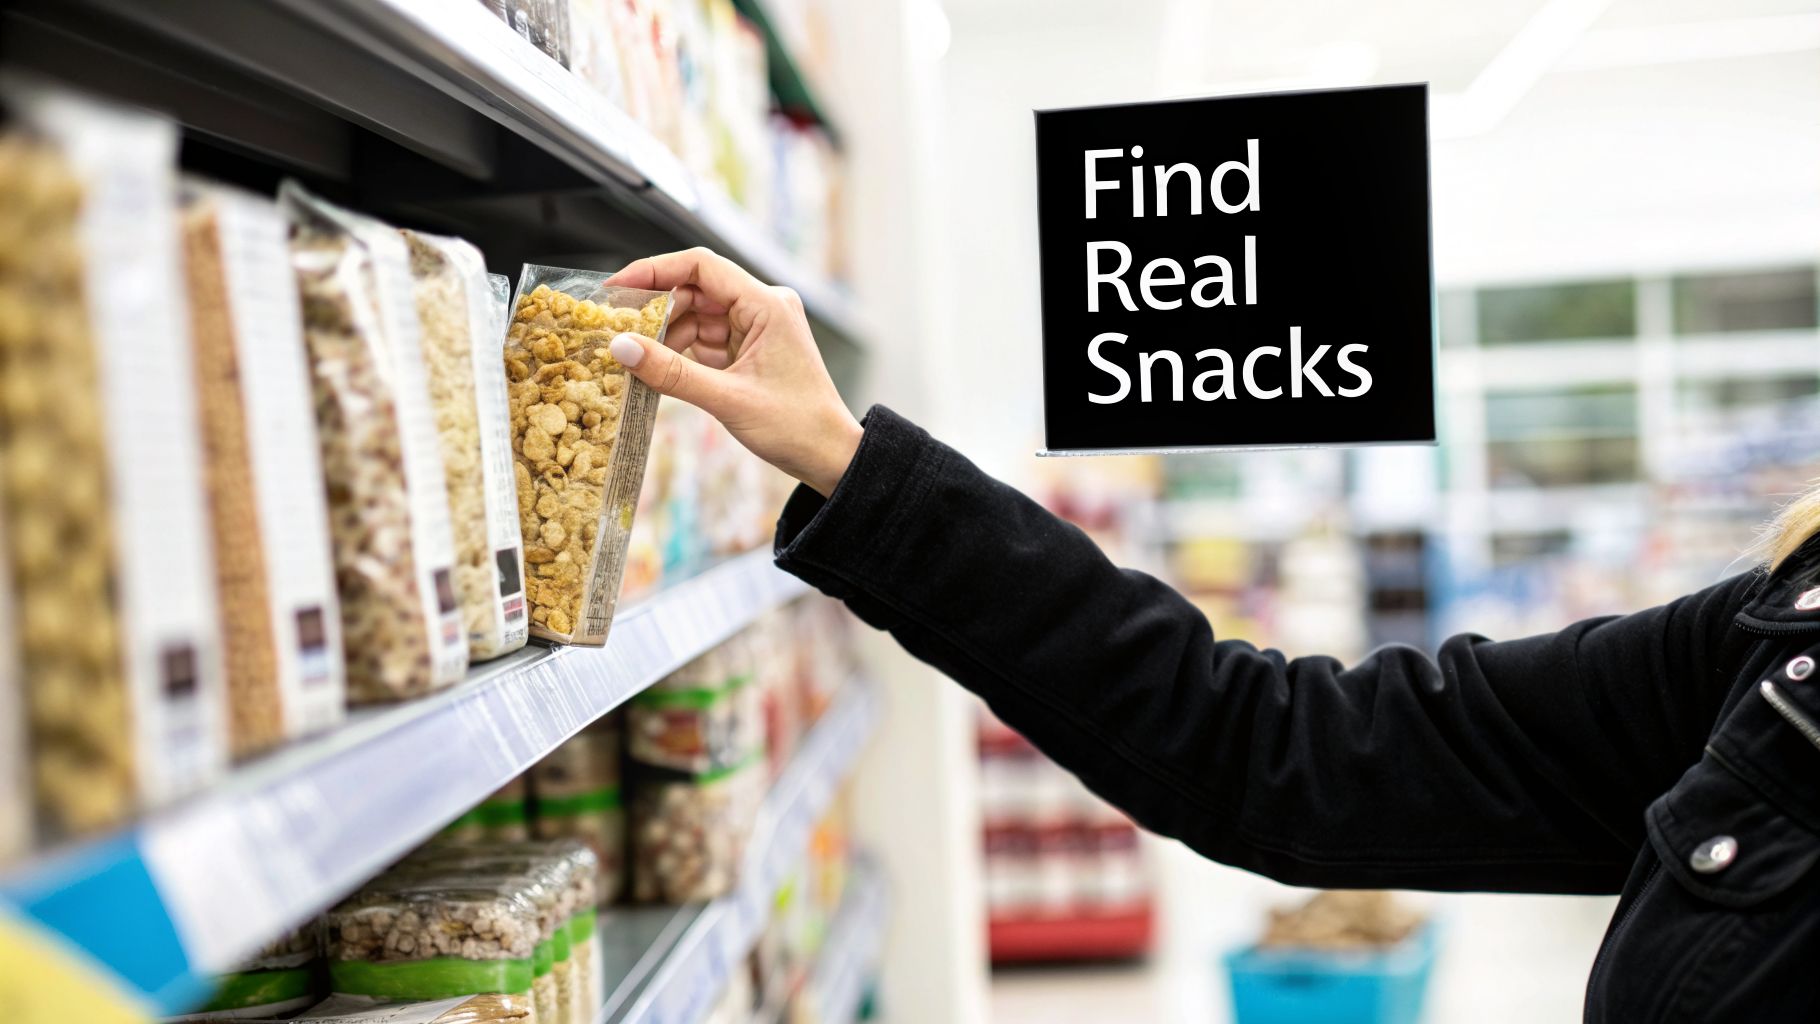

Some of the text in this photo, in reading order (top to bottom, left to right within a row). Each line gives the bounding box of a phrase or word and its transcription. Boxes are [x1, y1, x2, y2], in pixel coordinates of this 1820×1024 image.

[1085, 138, 1261, 219] Find
[1086, 235, 1258, 313] Real
[1087, 326, 1373, 405] Snacks
